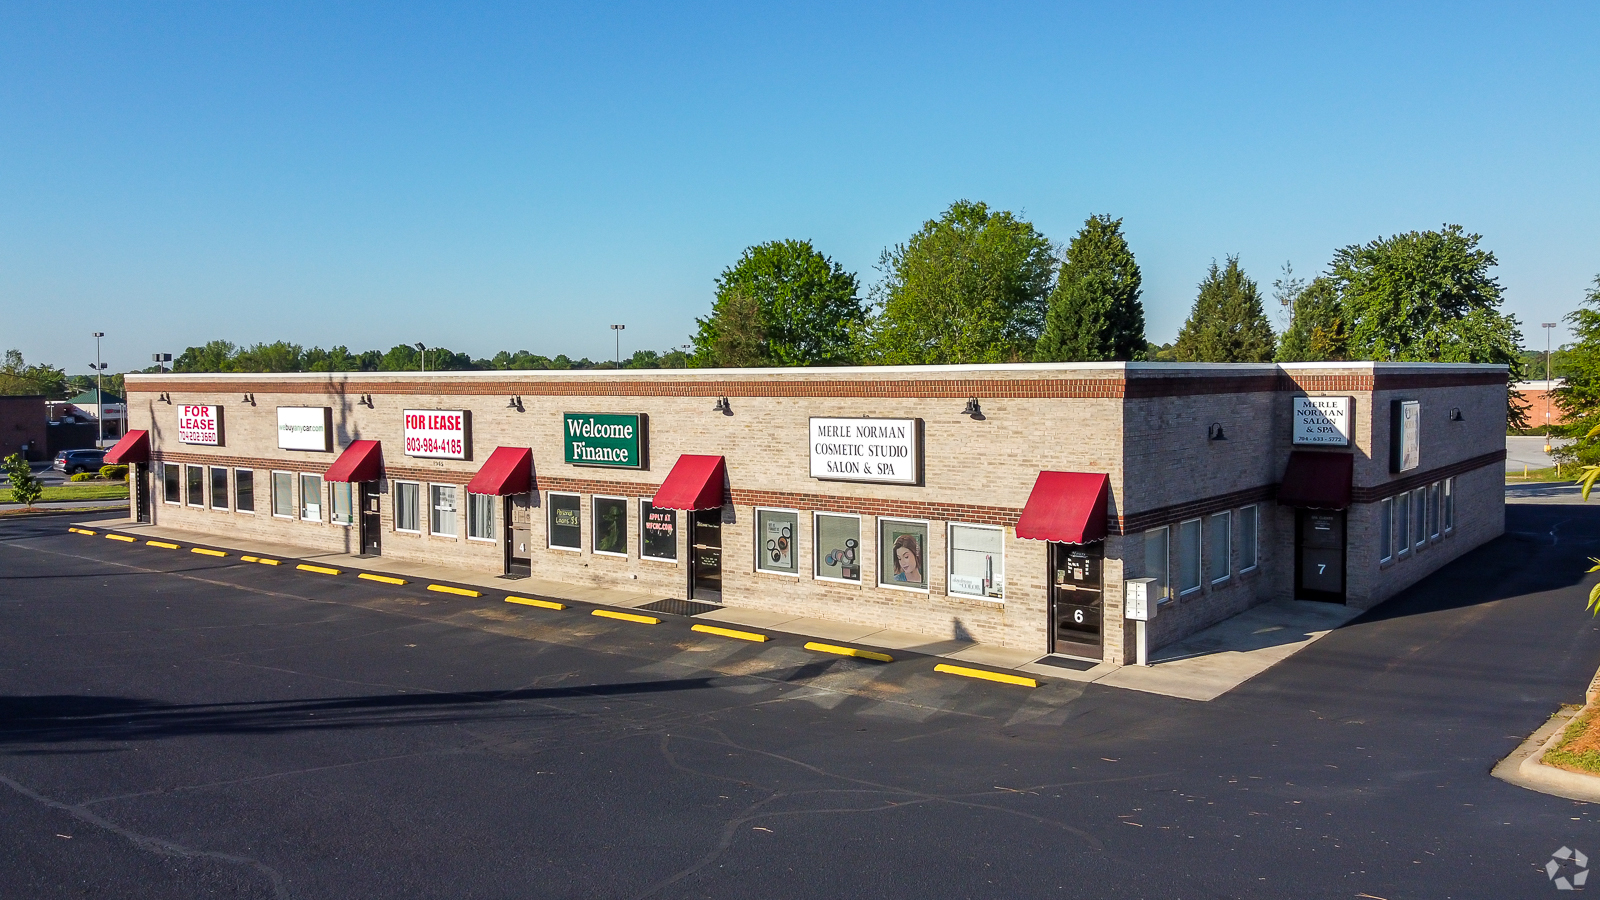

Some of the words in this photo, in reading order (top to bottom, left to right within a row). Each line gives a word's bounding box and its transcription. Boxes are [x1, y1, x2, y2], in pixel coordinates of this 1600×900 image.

[184, 405, 209, 417] FOR
[1302, 401, 1338, 409] MERLE
[1297, 409, 1344, 417] NORMAN
[180, 418, 215, 430] LEASE
[405, 414, 426, 430] FOR
[428, 415, 462, 431] LEASE
[1303, 417, 1337, 425] SALON
[279, 423, 324, 433] webuyanycar.com
[566, 418, 633, 439] Welcome
[817, 425, 852, 438] MERLE
[856, 425, 906, 439] NORMAN
[1316, 426, 1334, 434] SPA
[406, 437, 462, 454] 803-984-4185
[571, 441, 629, 462] Finance
[815, 443, 864, 457] COSMETIC
[868, 444, 908, 458] STUDIO
[827, 460, 860, 474] SALON
[863, 462, 872, 475] &
[877, 462, 896, 476] SPA
[648, 512, 664, 521] APPLY
[519, 542, 525, 553] 4
[1317, 563, 1326, 575] 7
[1074, 609, 1084, 624] 6
